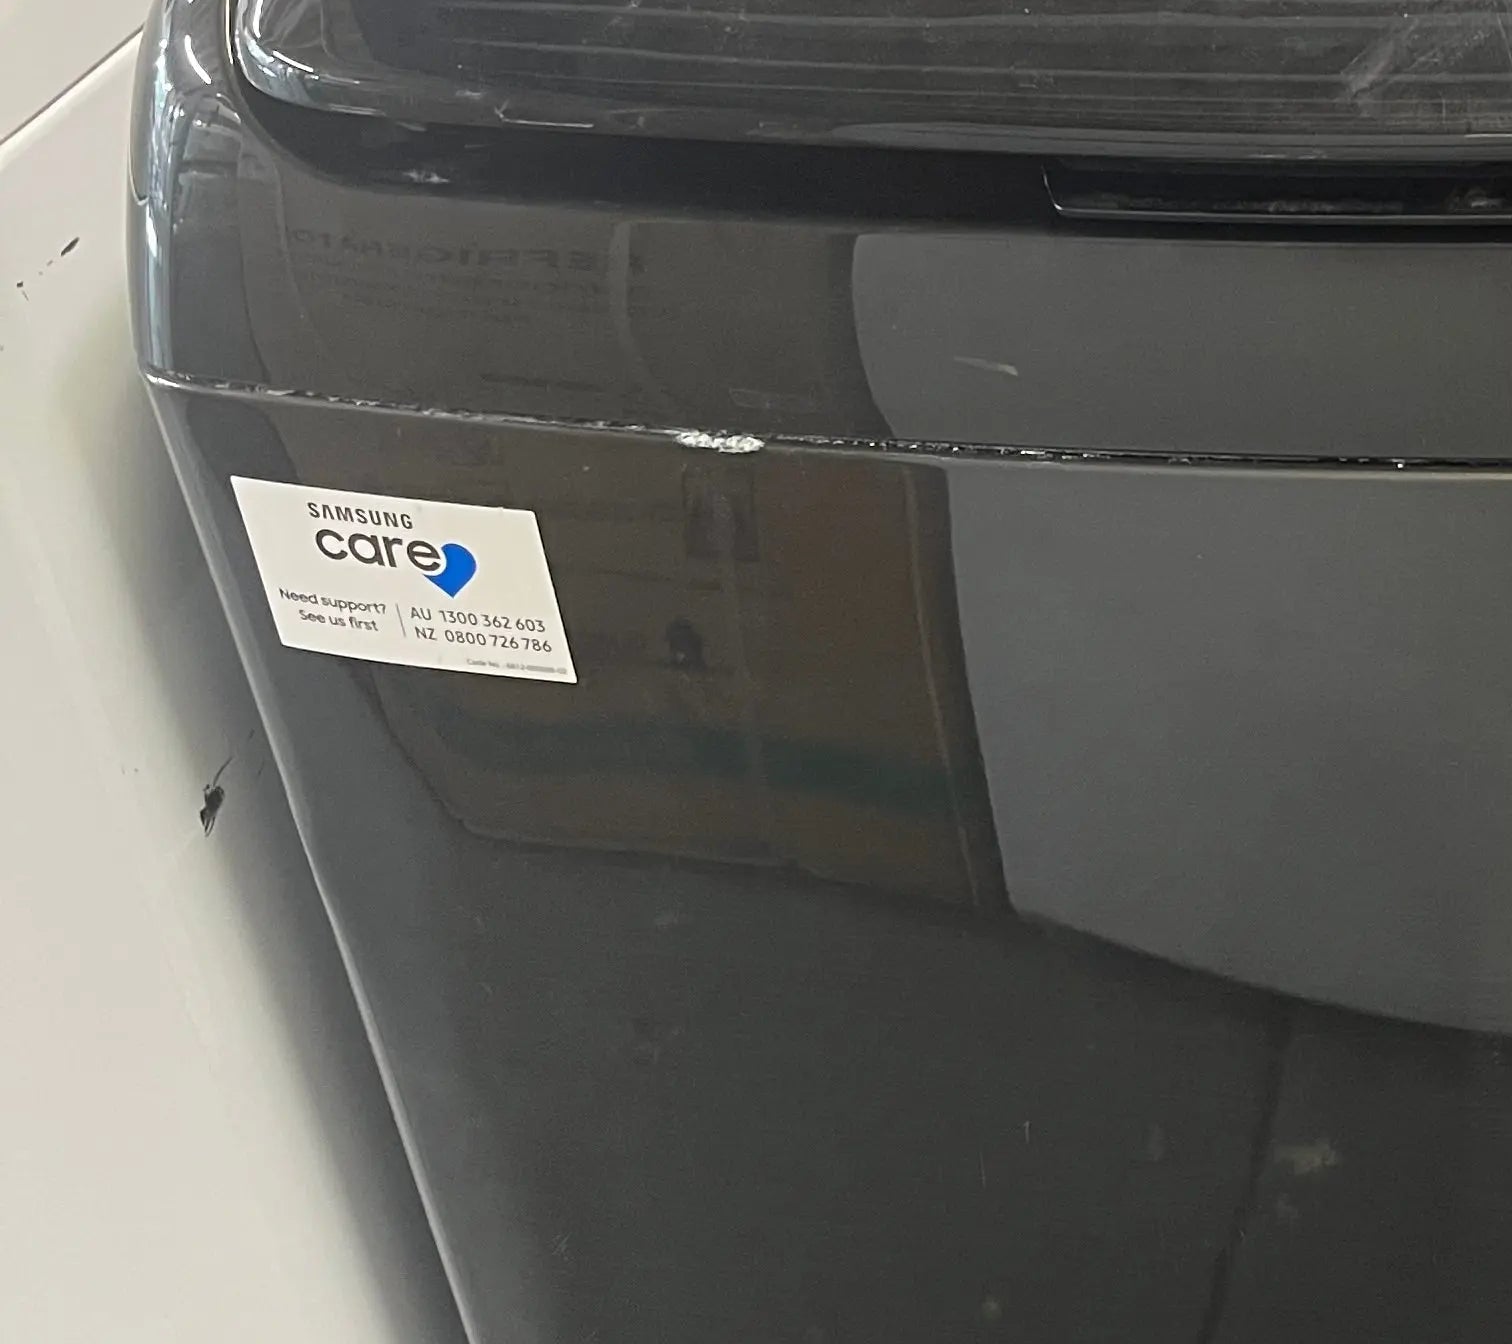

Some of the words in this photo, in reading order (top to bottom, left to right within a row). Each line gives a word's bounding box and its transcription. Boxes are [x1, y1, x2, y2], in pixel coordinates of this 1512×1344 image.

[307, 501, 414, 531] SAMSUNG
[315, 528, 441, 573] care
[278, 586, 319, 605] Need
[320, 596, 387, 616] support?
[298, 609, 326, 624] See
[329, 615, 347, 627] us
[349, 616, 378, 632] first
[410, 607, 432, 621] AU
[438, 610, 478, 626] 1300
[481, 614, 512, 630] 362
[516, 618, 546, 633] 603
[414, 626, 438, 641] NZ
[444, 629, 487, 646] 0800
[489, 634, 519, 650] 726
[521, 637, 553, 653] 786
